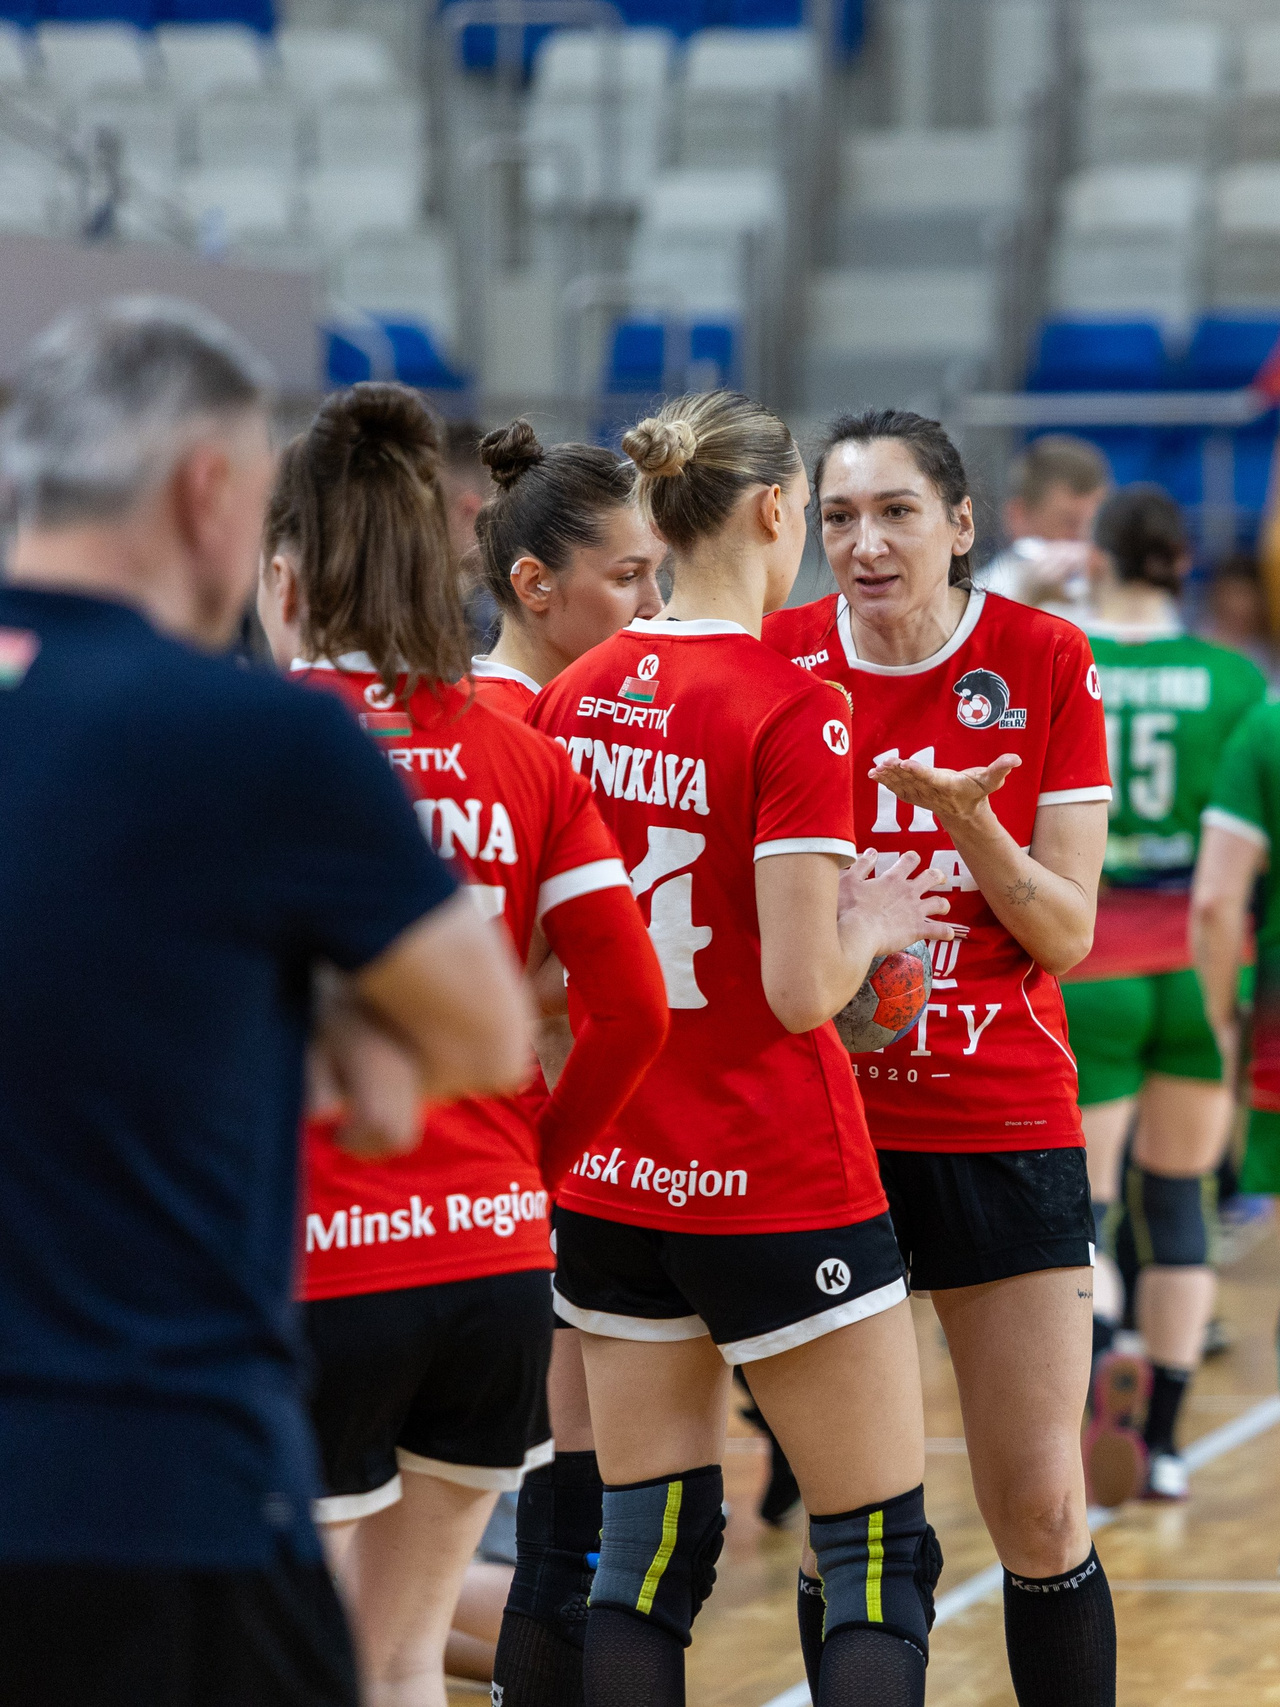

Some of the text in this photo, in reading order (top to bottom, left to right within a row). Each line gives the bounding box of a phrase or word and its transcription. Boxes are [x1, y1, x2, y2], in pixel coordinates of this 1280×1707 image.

[639, 657, 657, 677] K
[791, 649, 829, 671] mpa
[577, 696, 676, 738] SPORTIX
[1004, 710, 1025, 719] BNTU
[826, 722, 847, 752] K
[388, 742, 467, 781] RTIX
[554, 736, 711, 816] TNIKAVA
[413, 798, 518, 865] INA
[569, 1147, 748, 1207] nsk Region
[306, 1181, 548, 1253] Minsk Region
[819, 1261, 847, 1292] K
